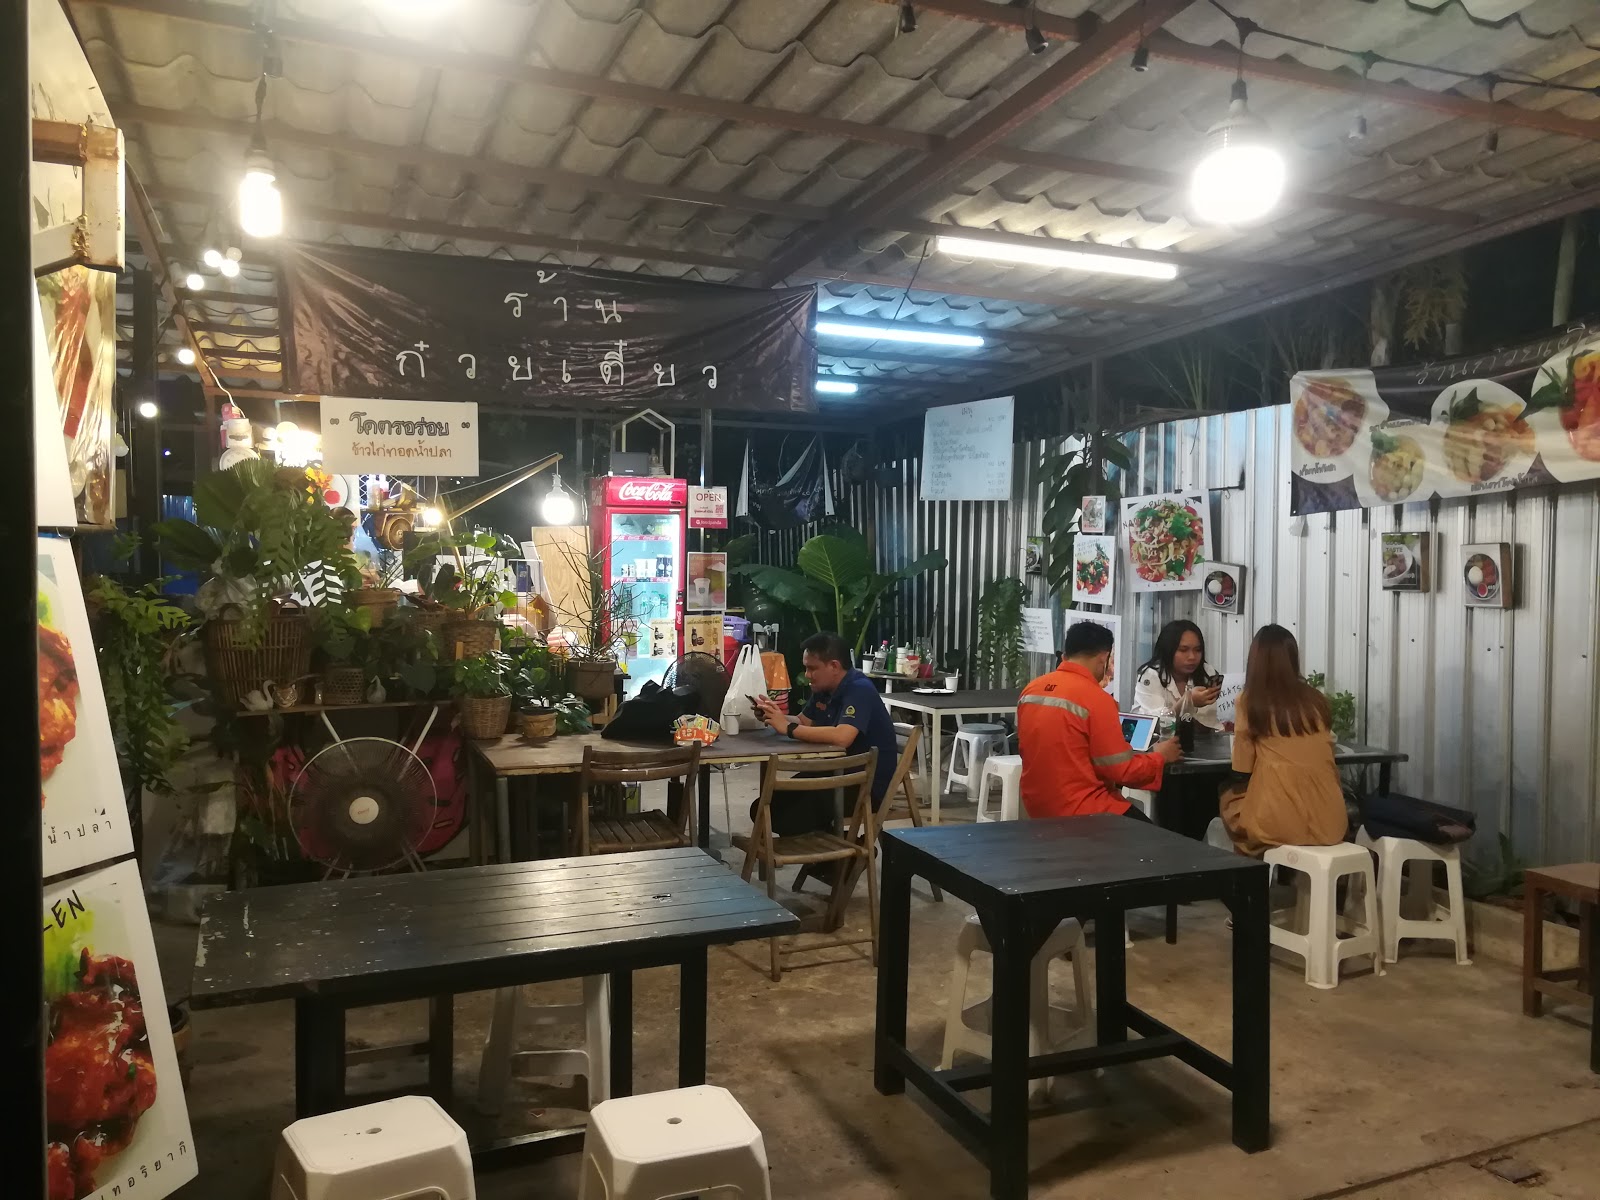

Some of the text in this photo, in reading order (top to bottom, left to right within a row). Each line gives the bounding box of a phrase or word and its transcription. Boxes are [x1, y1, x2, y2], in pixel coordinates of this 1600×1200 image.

[504, 268, 622, 324] ร้าน
[396, 339, 718, 389] ก๋วยเตี๋ยว
[351, 439, 452, 458] ข้าวไก่ทอดน้ำปลา
[618, 481, 675, 501] Coca-Cola
[696, 492, 722, 502] OPEN
[1044, 683, 1058, 692] CAT
